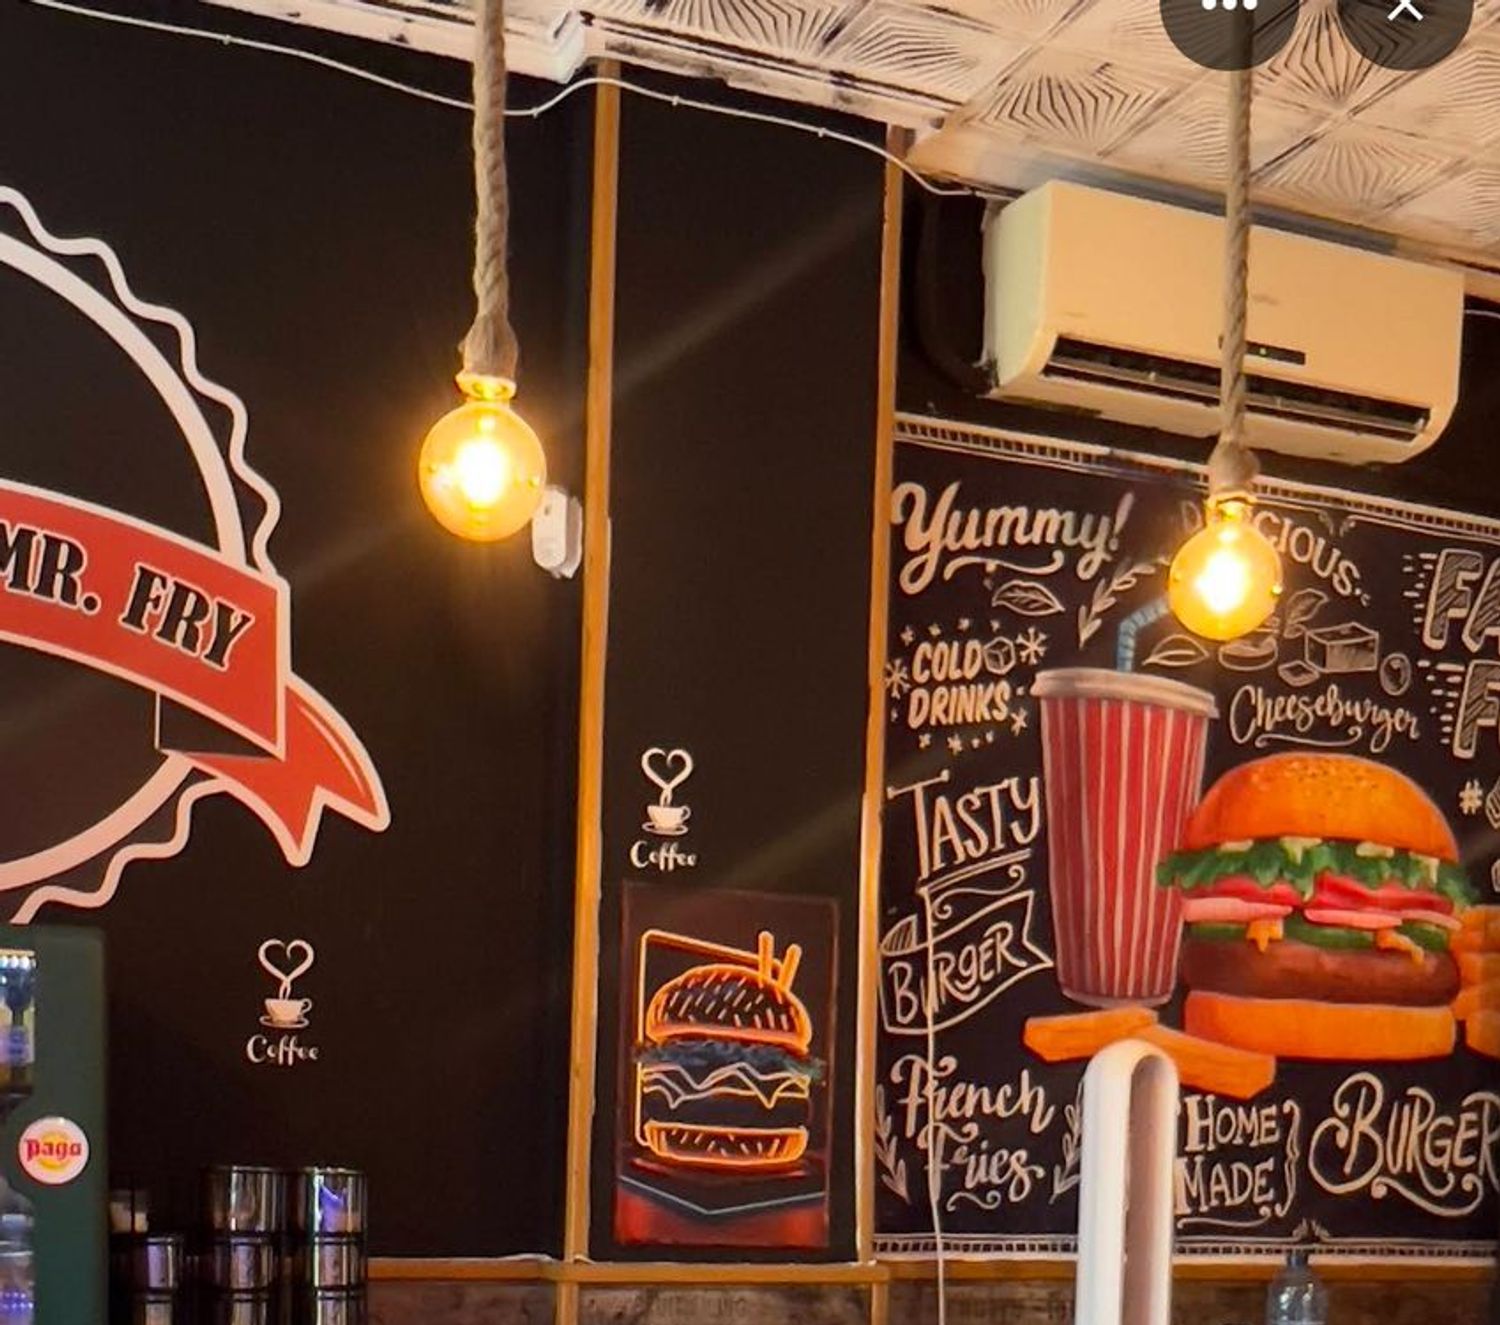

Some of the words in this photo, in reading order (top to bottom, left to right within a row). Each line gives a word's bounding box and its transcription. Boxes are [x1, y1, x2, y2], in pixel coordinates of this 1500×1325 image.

[891, 481, 1134, 595] Yummy!
[0, 520, 101, 615] MR.
[119, 562, 255, 671] FRY
[912, 639, 982, 684] COLD
[908, 680, 1010, 729] DRINKS
[1230, 684, 1420, 753] Cheeseburger
[630, 840, 697, 871] Coffee
[887, 769, 1040, 880] TASTY
[245, 1033, 320, 1066] Coffee
[891, 1055, 1053, 1139] French
[1184, 1095, 1280, 1152] HOME
[1309, 1072, 1500, 1196] BURGER
[1175, 1155, 1275, 1216] MADE
